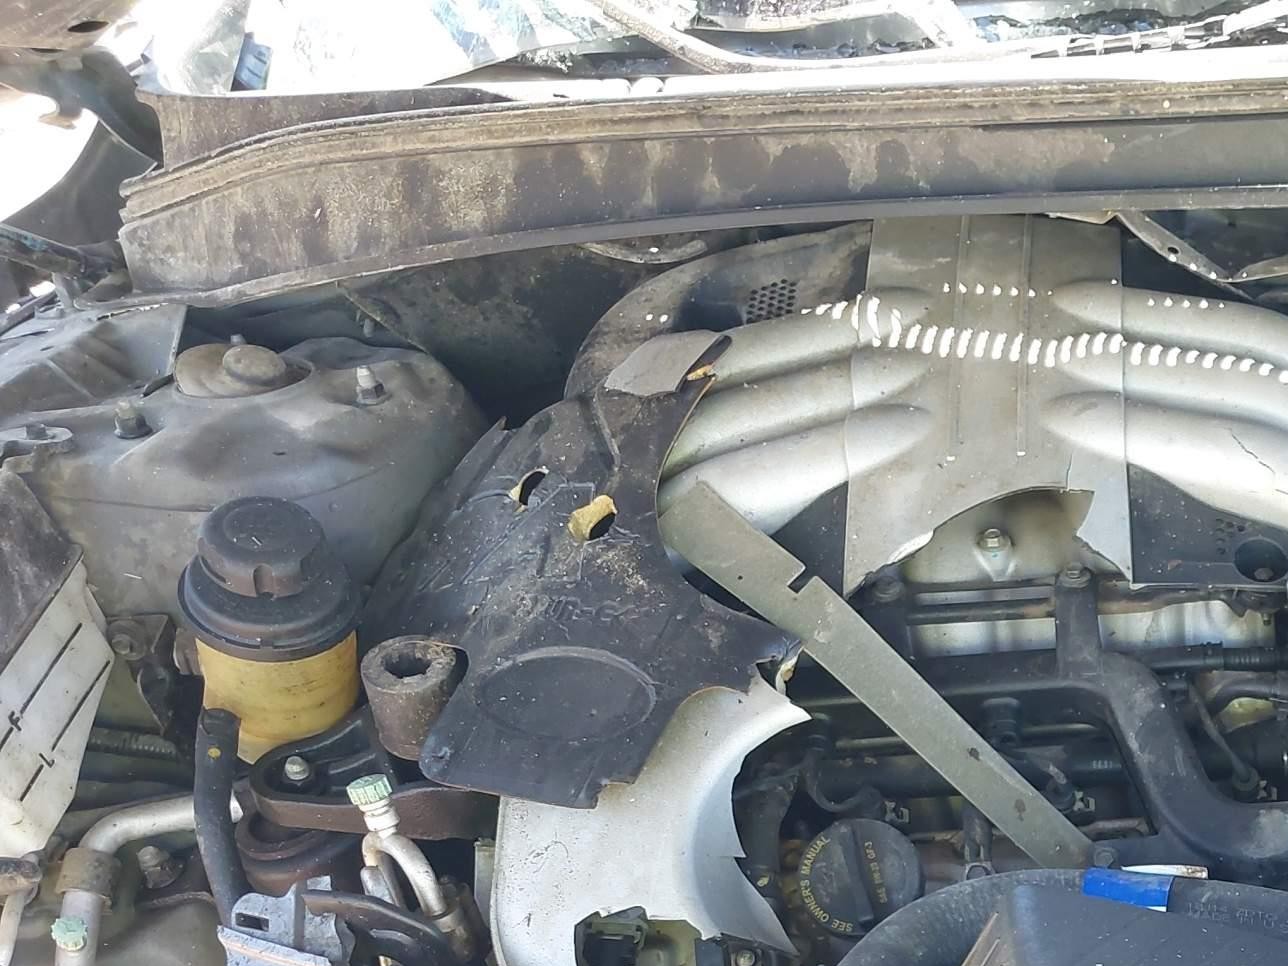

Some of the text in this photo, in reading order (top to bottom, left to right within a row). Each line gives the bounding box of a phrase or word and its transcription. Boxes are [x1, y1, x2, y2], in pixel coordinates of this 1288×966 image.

[800, 834, 854, 932] SEE OWNER'S MANUAL
